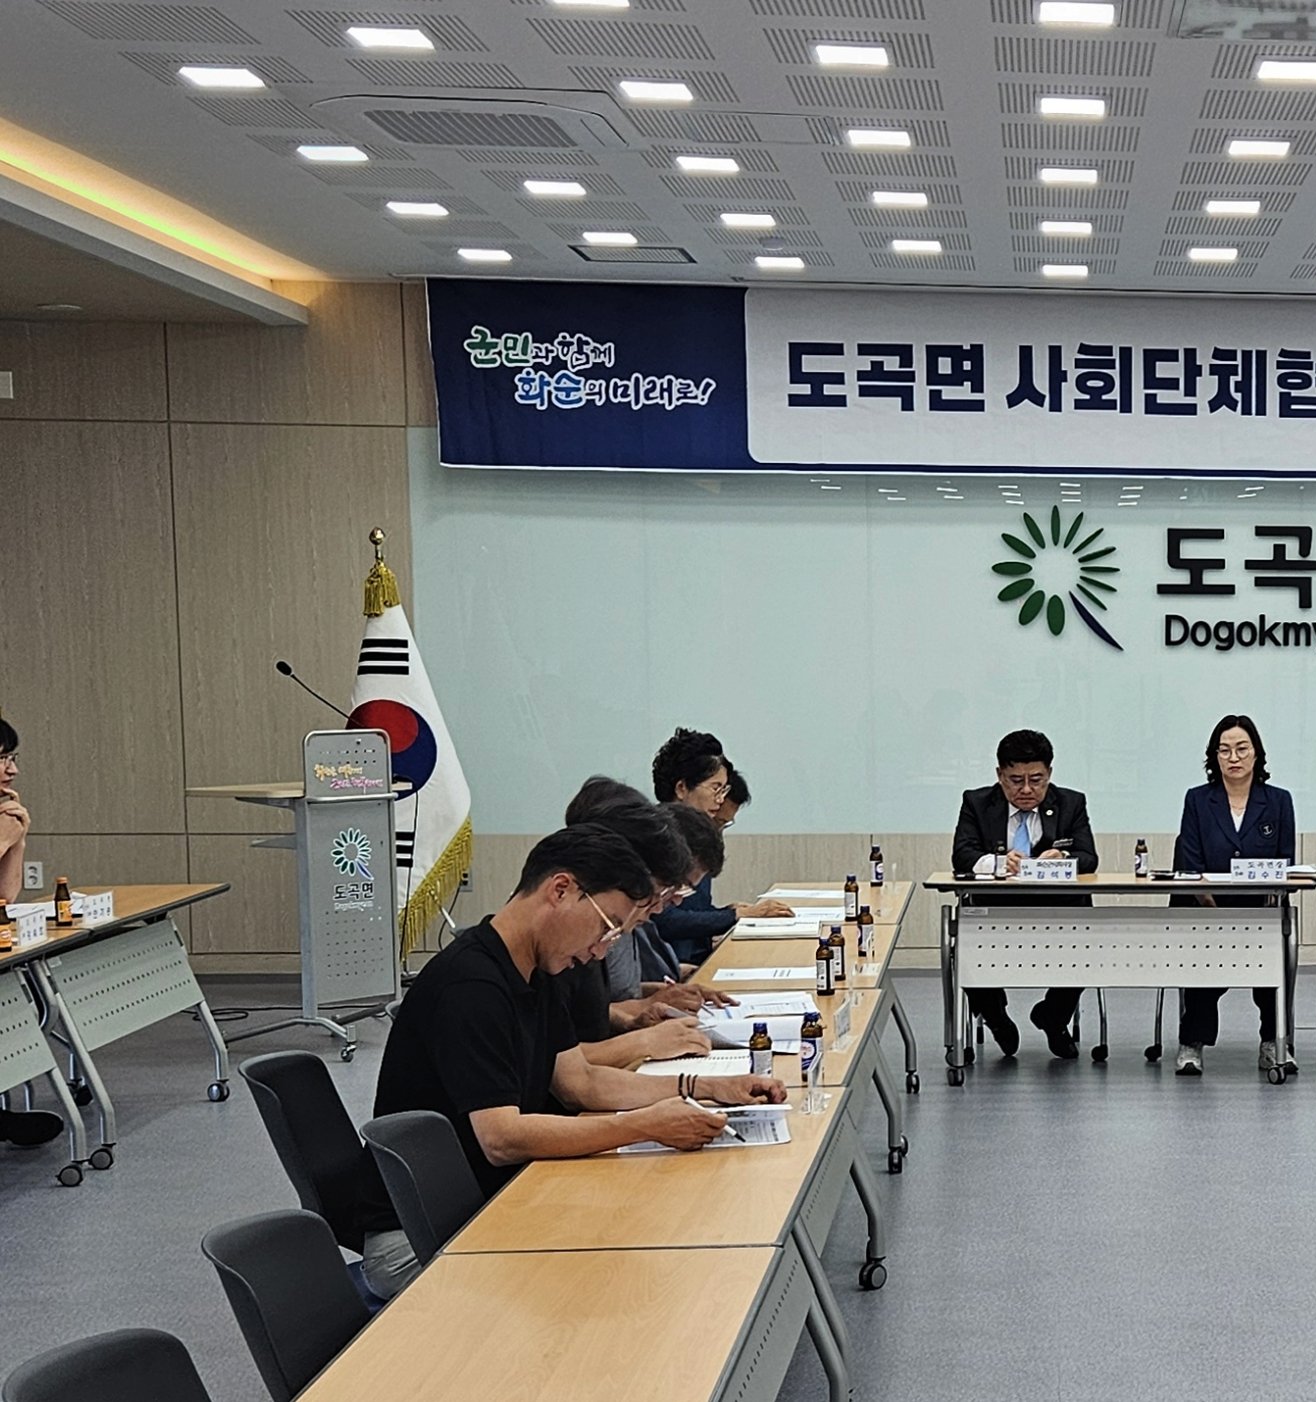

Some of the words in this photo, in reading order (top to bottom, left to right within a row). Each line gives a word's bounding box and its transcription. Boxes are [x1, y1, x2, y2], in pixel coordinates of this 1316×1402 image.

[464, 325, 556, 368] 군민과
[554, 332, 615, 371] 함께
[514, 367, 606, 410] 화순의
[609, 372, 717, 410] 미래로!
[787, 341, 985, 413] 도곡면
[334, 882, 375, 900] 도곡면
